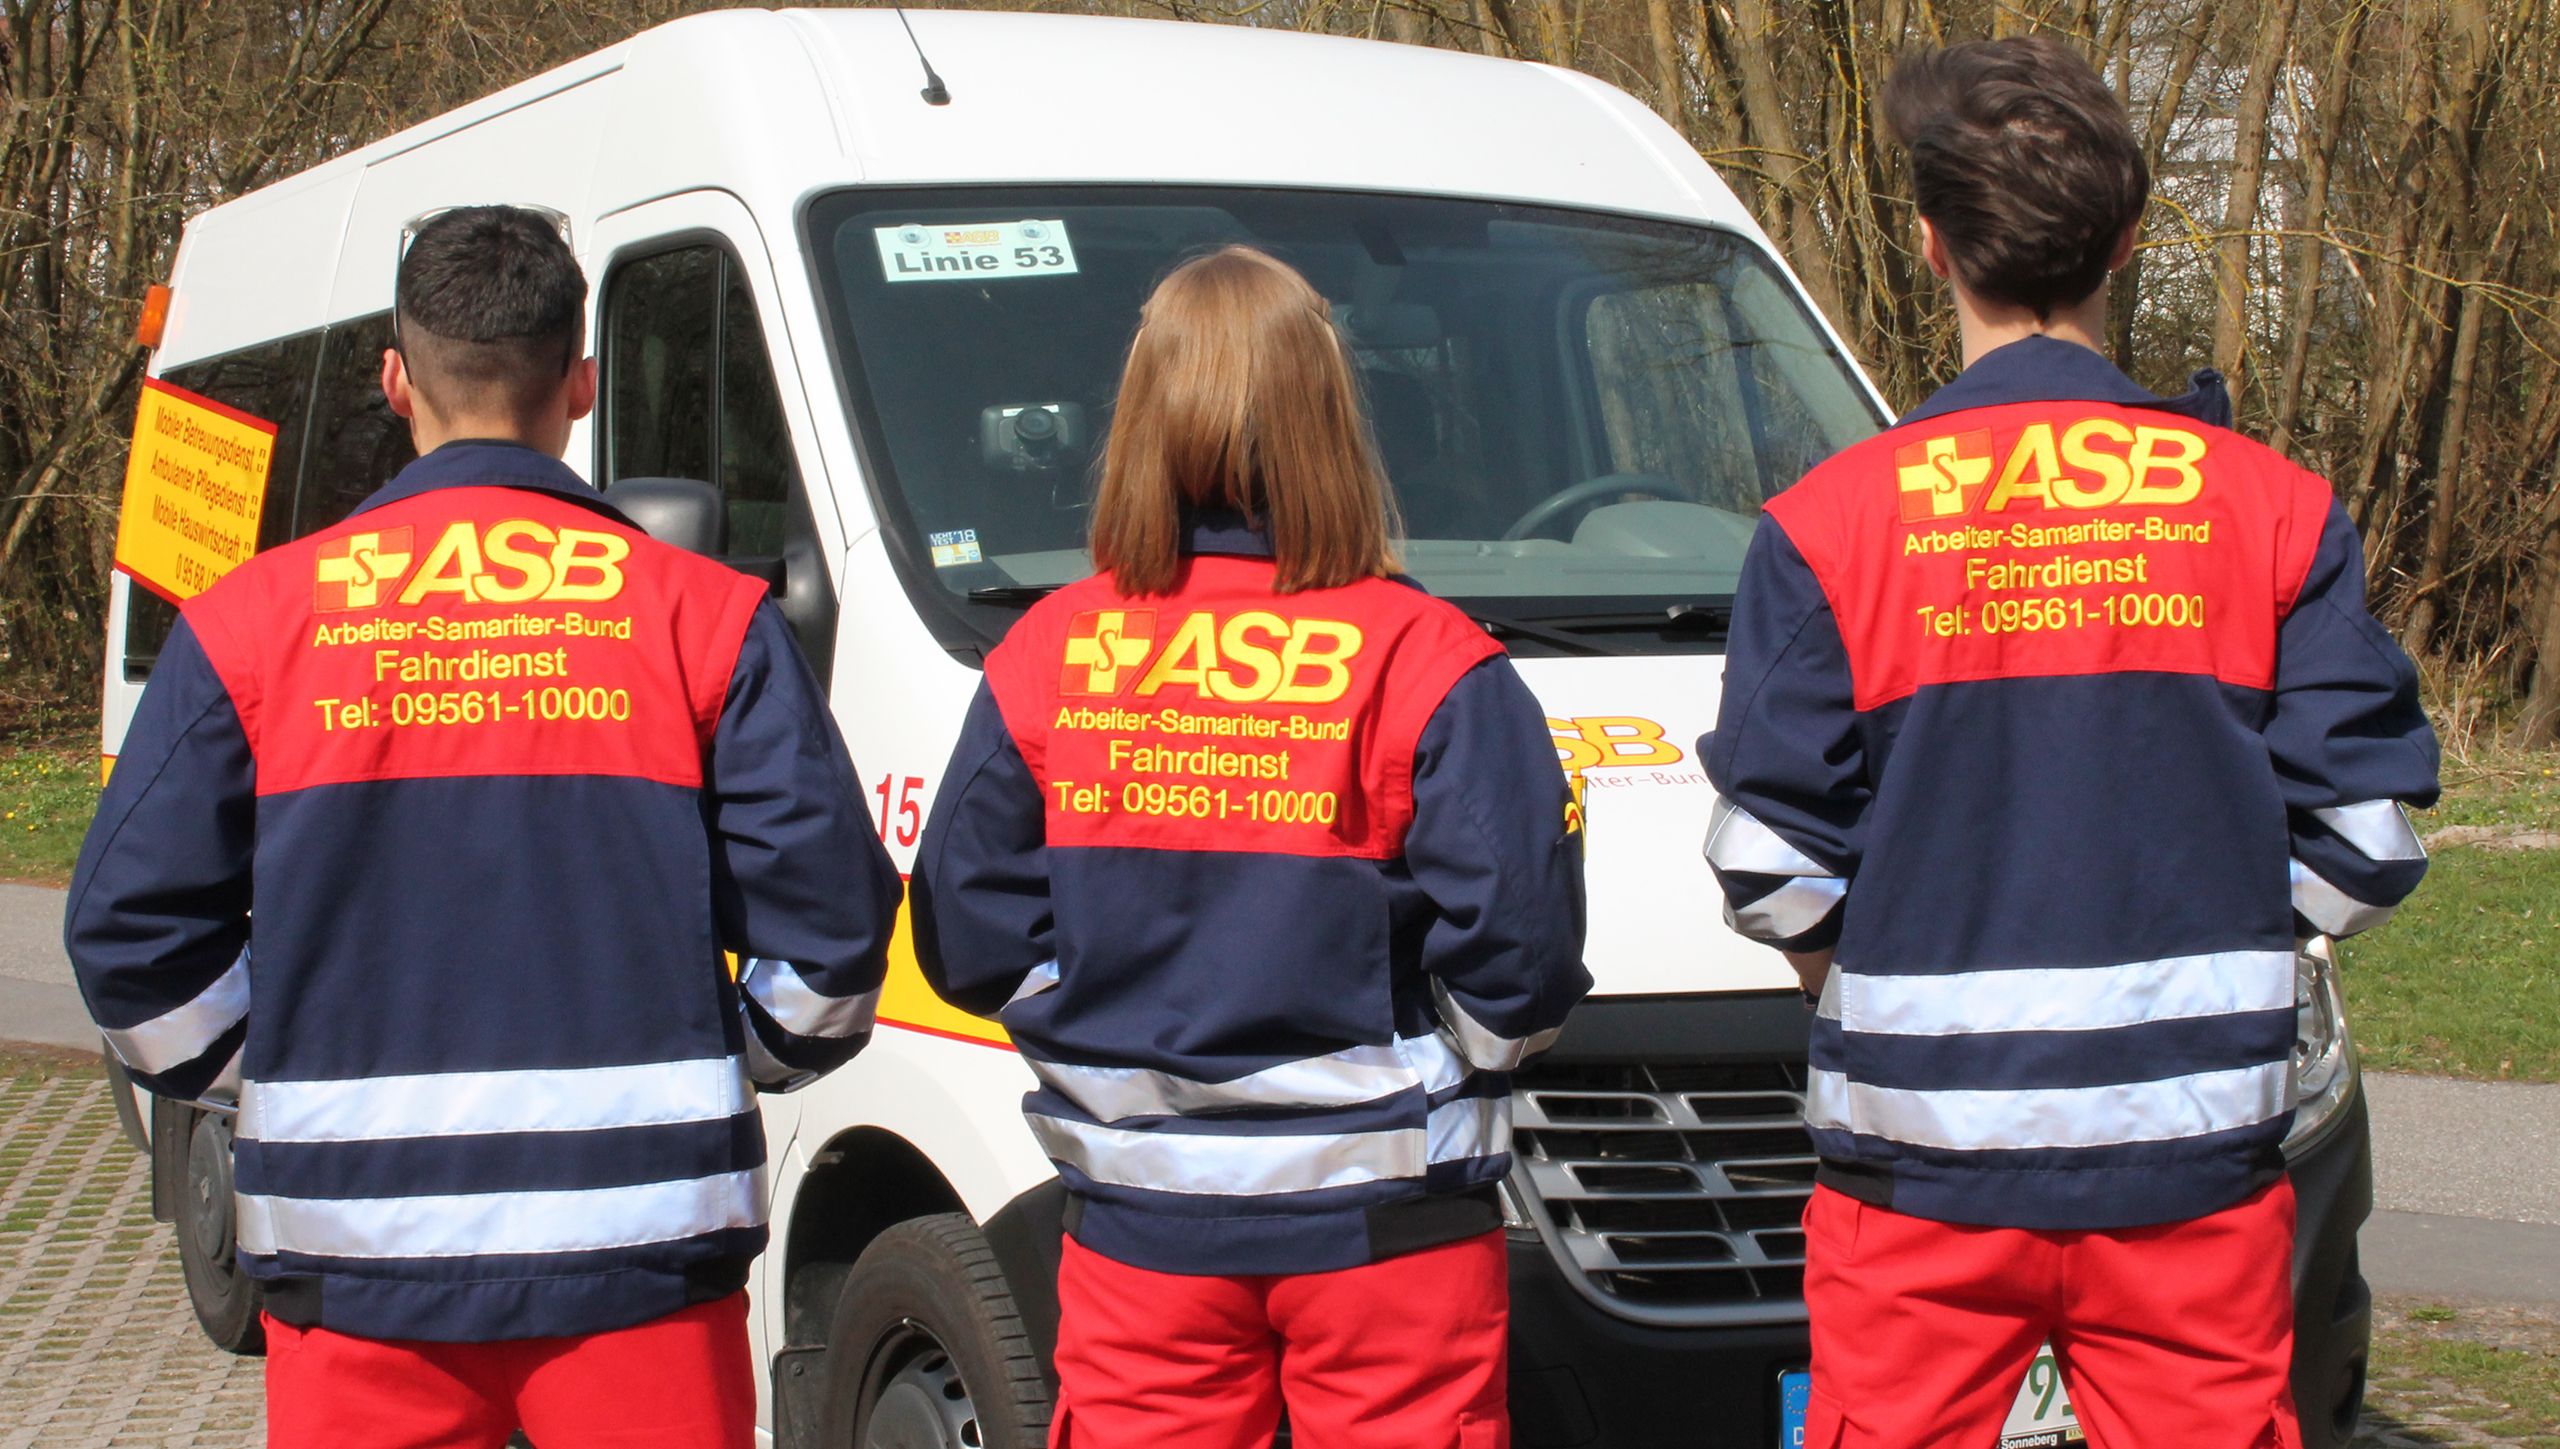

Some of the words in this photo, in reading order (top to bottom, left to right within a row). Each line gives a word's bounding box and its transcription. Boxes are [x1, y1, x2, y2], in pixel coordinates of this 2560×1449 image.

[894, 251, 1000, 273] Linie
[1014, 246, 1065, 268] 53
[155, 405, 184, 440] Mobiler
[182, 417, 256, 473] Betreuungsdienst
[151, 449, 195, 492] Ambulanter
[194, 468, 247, 518] Pflegedienst
[1984, 417, 2207, 511] ASB
[152, 494, 178, 531] Mobile
[178, 507, 240, 563] Hauswirtschaft
[1904, 517, 2210, 555] Arbeiter-Samariter-Bund
[398, 518, 630, 604] ASB
[1966, 552, 2147, 590] Fahrdienst
[314, 612, 631, 647] Arbeiter-Samariter-Bund
[1917, 604, 1971, 637] Tel:
[1981, 593, 2205, 635] 09561-10000
[375, 646, 568, 682] Fahrdienst
[1133, 611, 1362, 703] ASB
[314, 696, 379, 731] Tel:
[391, 687, 631, 726] 09561-10000
[1055, 707, 1349, 740] Arbeiter-Samariter-Bund
[1109, 740, 1290, 780] Fahrdienst
[1546, 716, 1684, 771] SB
[1588, 772, 1708, 789] iter-Bun
[876, 773, 924, 847] 15
[1052, 781, 1111, 814] Tel:
[1123, 782, 1337, 824] 09561-10000
[2001, 1434, 2057, 1449] Sonneberg
